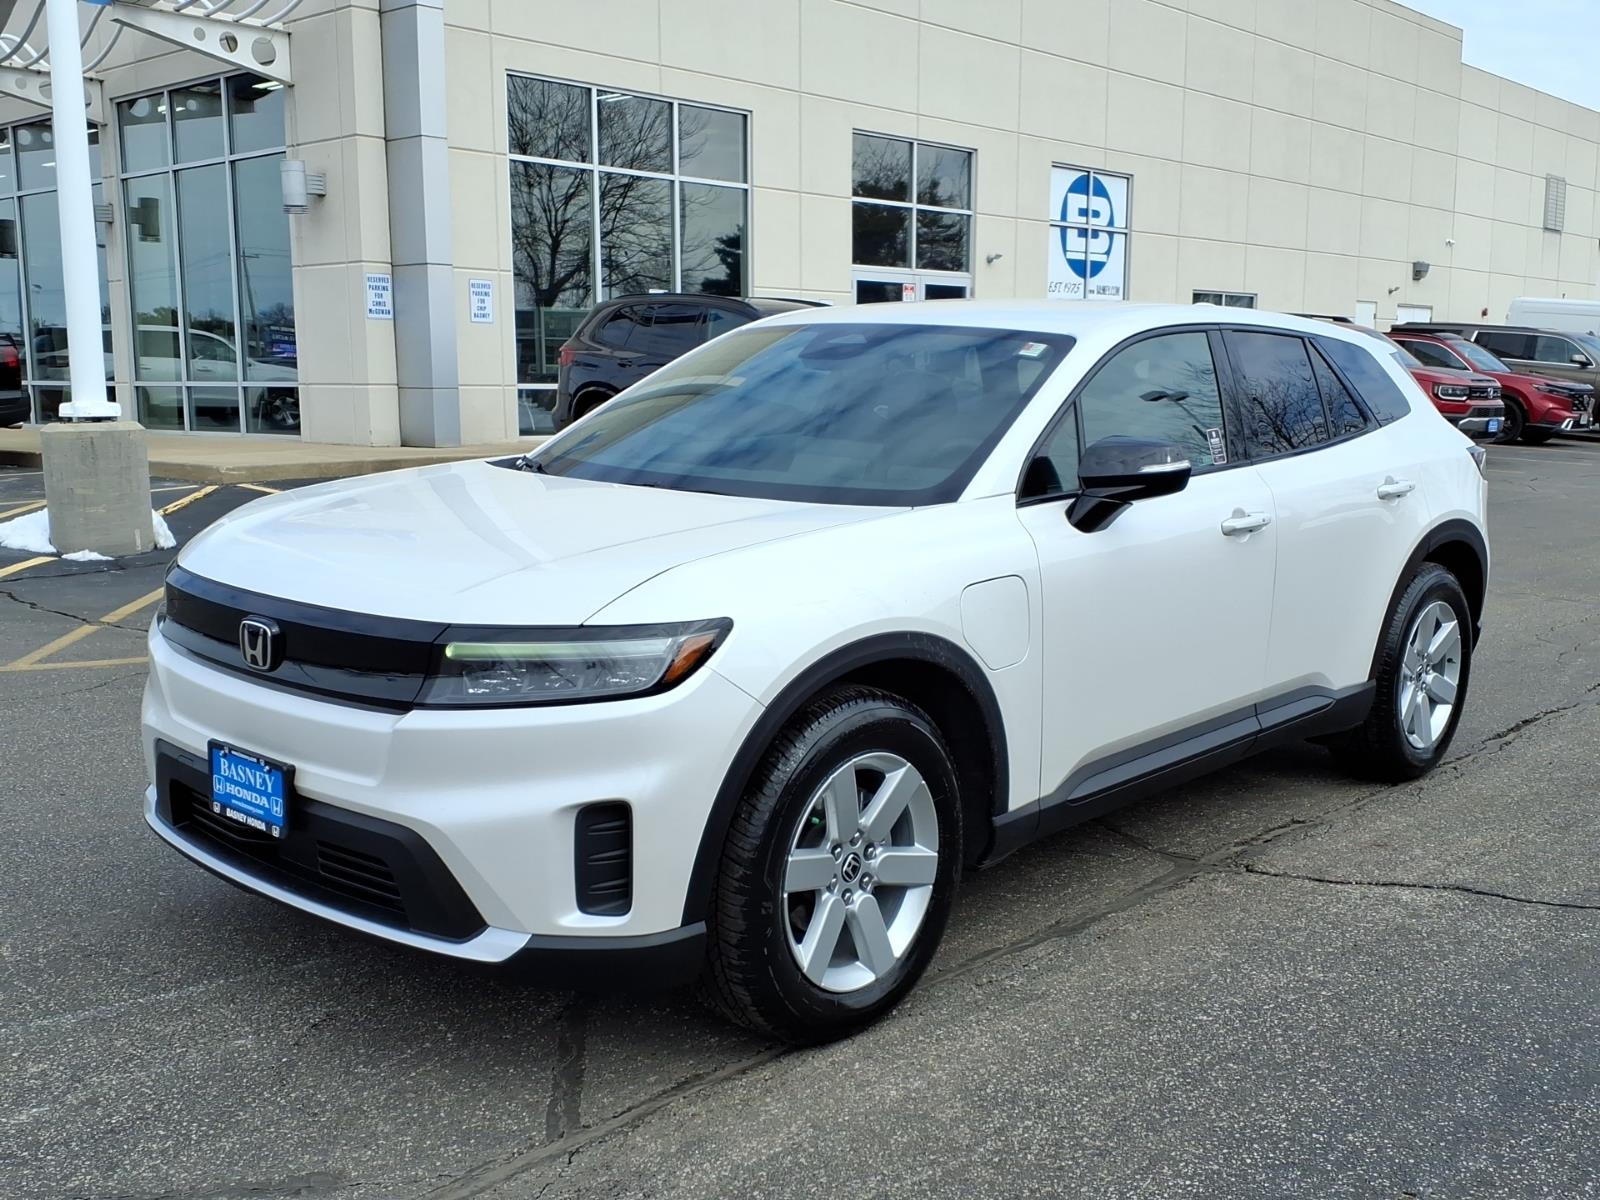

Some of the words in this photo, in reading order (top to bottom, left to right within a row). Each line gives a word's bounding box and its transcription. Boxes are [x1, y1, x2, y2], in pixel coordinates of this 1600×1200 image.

[1066, 192, 1111, 255] B
[1063, 282, 1082, 294] 1975
[219, 757, 275, 793] BASNEY
[225, 782, 270, 808] HONDA
[226, 807, 247, 823] BASNEY
[247, 815, 266, 831] HONDA
